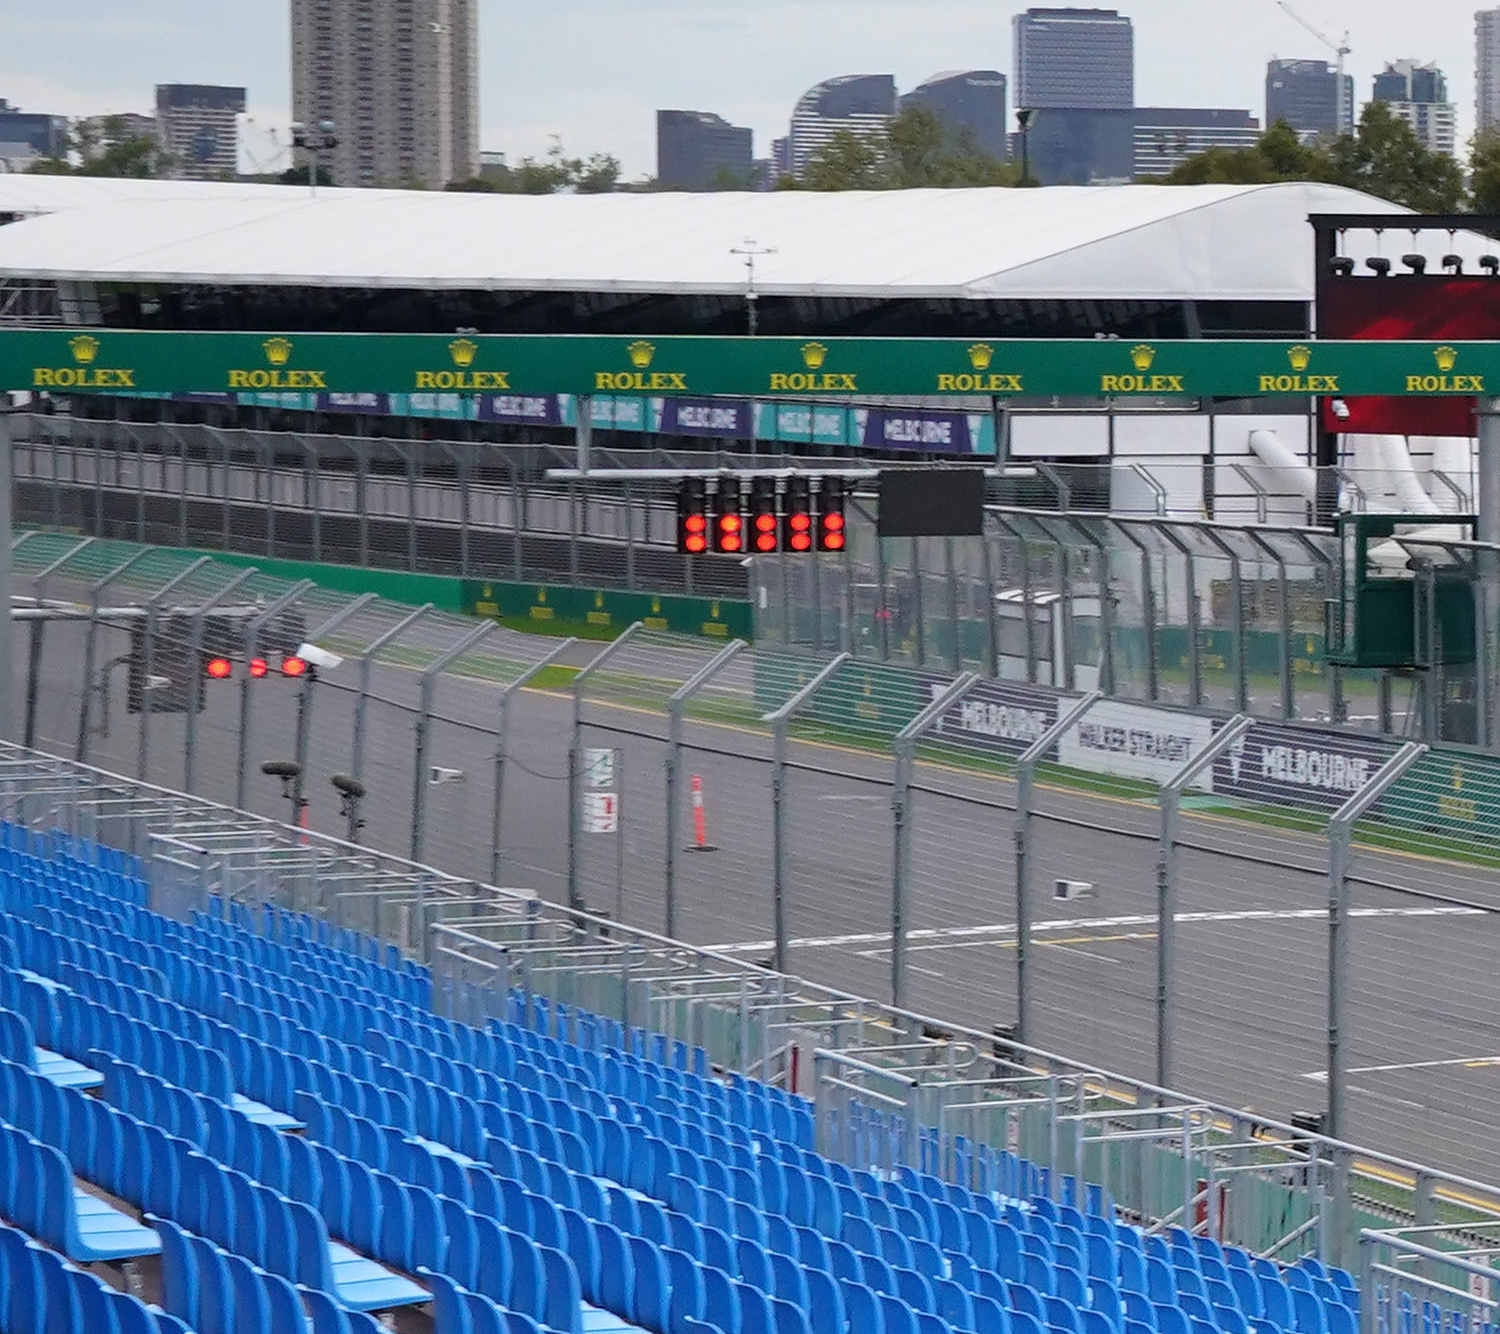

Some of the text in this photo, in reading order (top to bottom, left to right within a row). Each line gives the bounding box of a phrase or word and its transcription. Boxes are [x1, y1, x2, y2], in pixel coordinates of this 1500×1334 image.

[34, 368, 134, 387] ROLEX
[229, 370, 326, 387] ROLEX
[416, 371, 509, 388] ROLEX
[596, 372, 687, 389] ROLEX
[771, 373, 857, 390] ROLEX
[938, 374, 1022, 391] ROLEX
[1102, 375, 1183, 391] ROLEX
[1260, 376, 1339, 391] ROLEX
[1406, 376, 1484, 391] ROLEX
